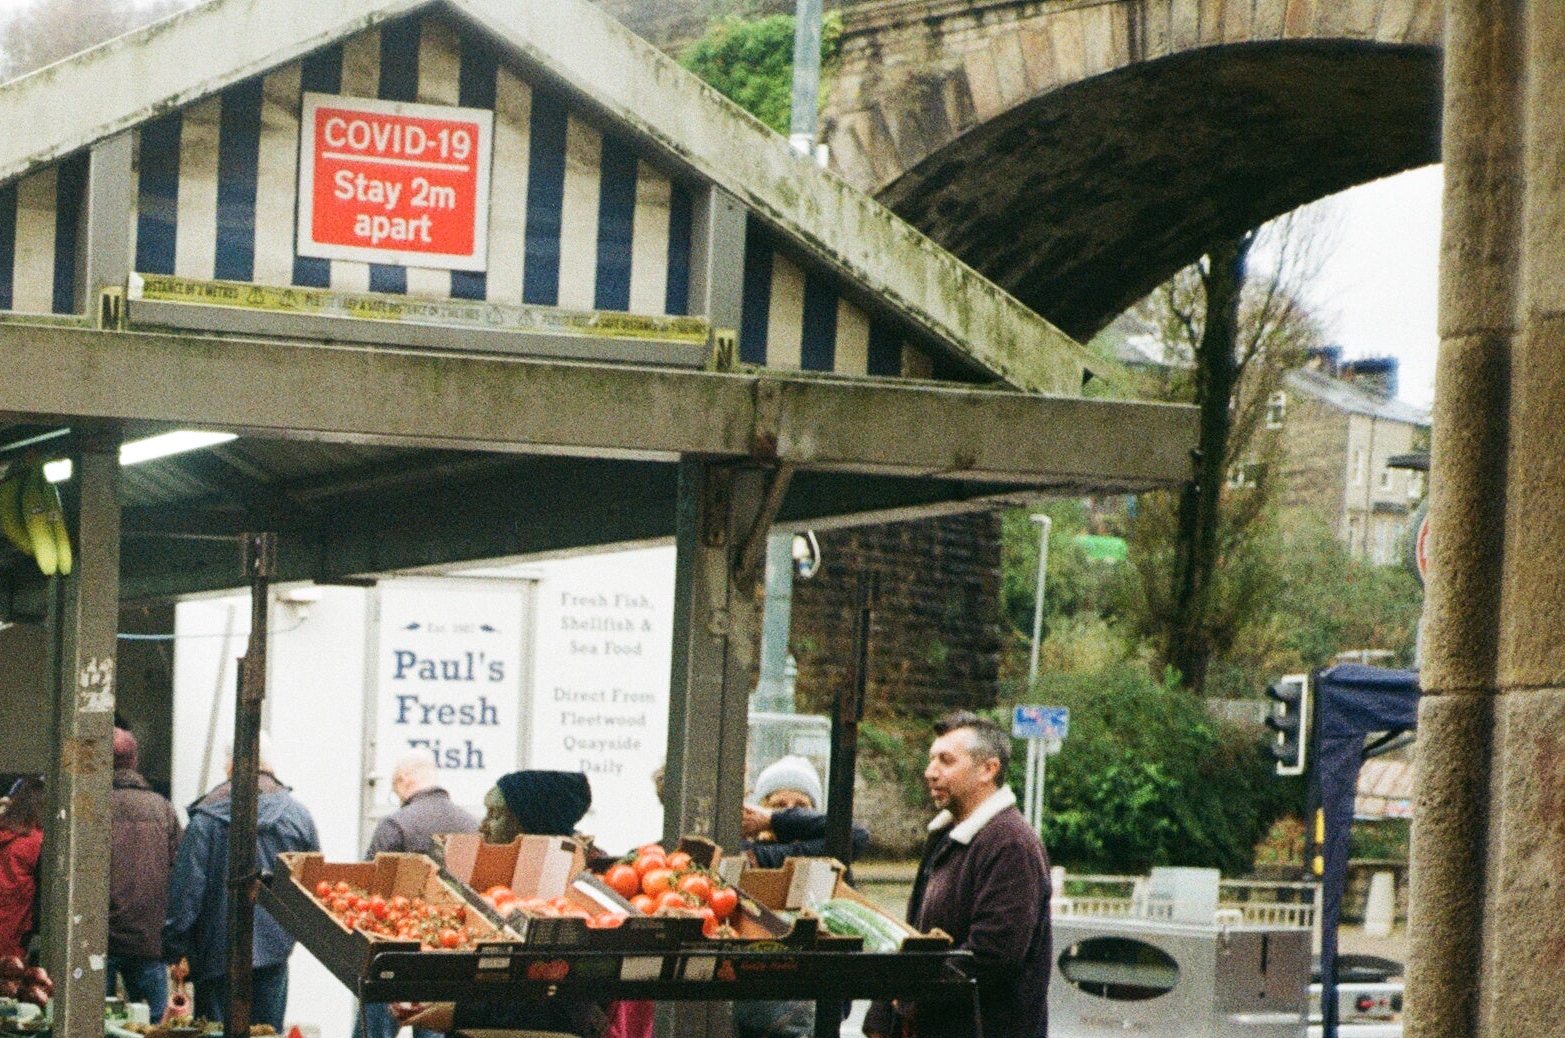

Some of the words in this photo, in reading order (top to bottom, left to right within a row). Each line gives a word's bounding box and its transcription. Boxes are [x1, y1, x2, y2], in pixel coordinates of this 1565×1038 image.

[324, 118, 472, 160] COVID-19
[334, 169, 403, 211] Stay
[410, 176, 456, 210] 2m
[353, 213, 433, 245] apart
[560, 591, 608, 607] Fresh
[560, 615, 635, 632] Shellfish
[569, 639, 598, 655] Sea
[603, 640, 643, 656] Food
[393, 649, 505, 682] Paul's
[553, 686, 606, 702] Direct
[611, 687, 656, 703] From
[395, 694, 500, 726] Fresh
[560, 711, 647, 727] Fleetwood
[562, 735, 642, 752] Quayside
[579, 758, 624, 777] Daily
